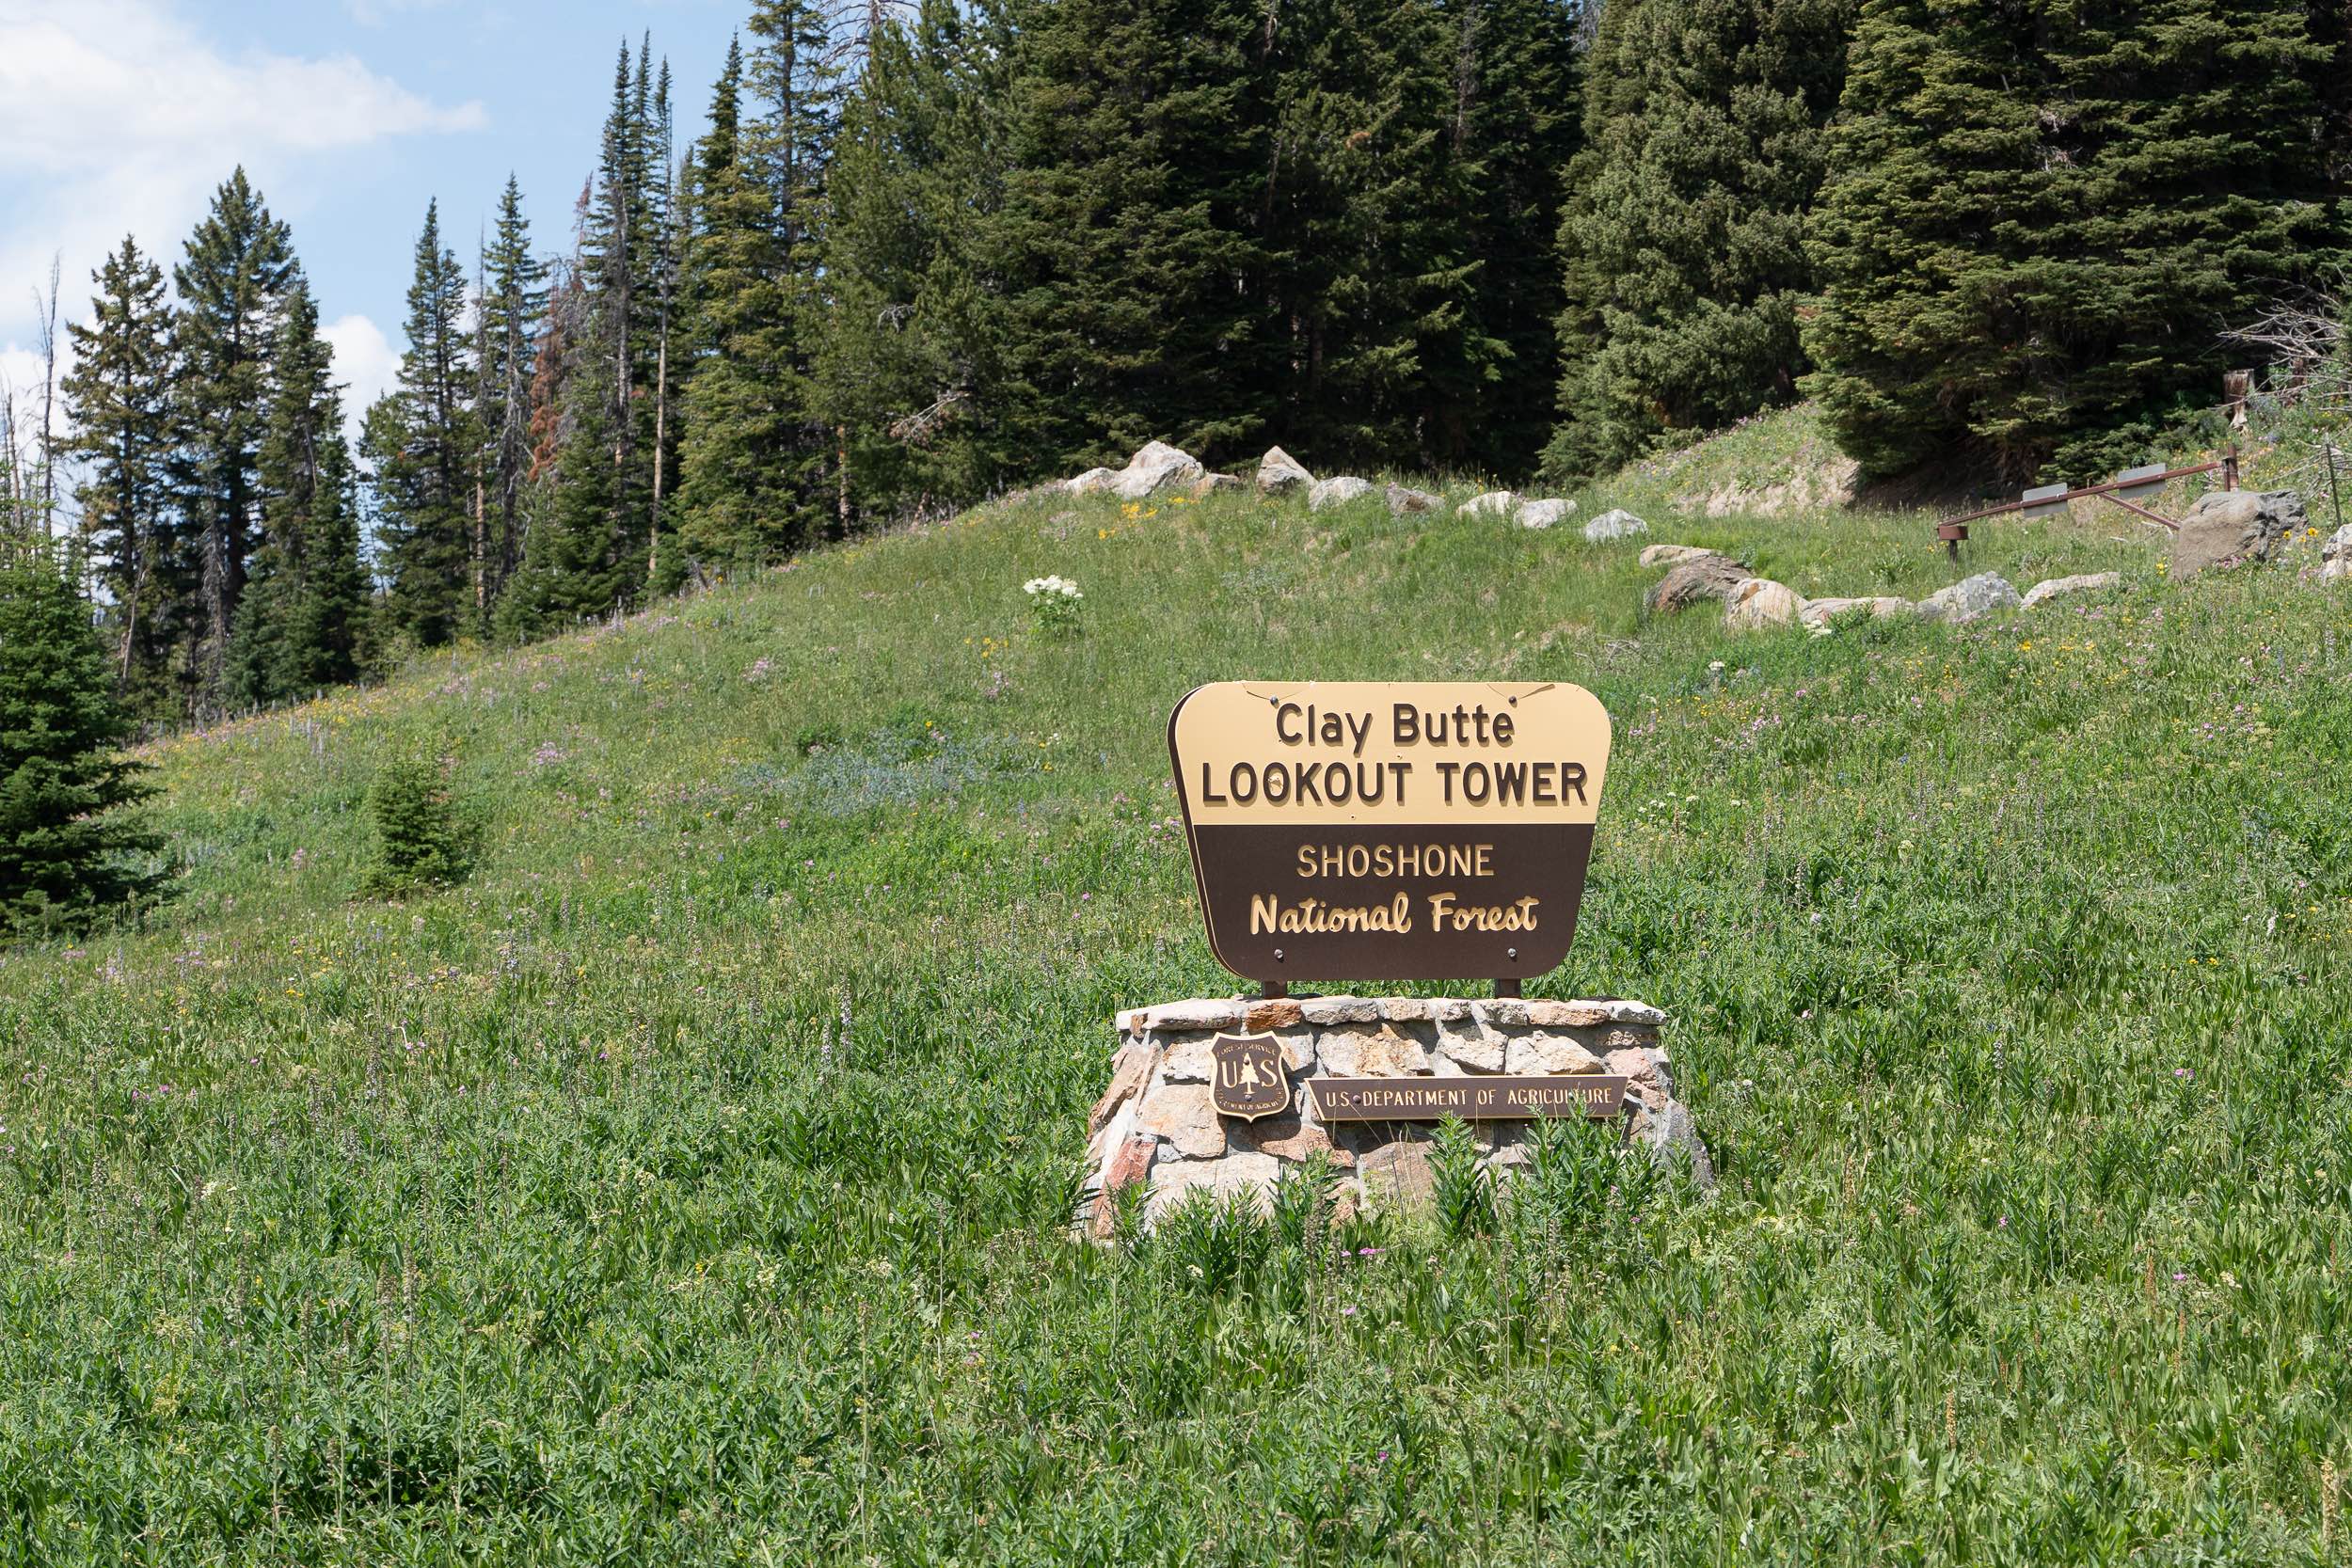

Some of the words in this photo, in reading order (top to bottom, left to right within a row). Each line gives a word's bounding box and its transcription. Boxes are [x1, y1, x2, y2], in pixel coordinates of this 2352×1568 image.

[1276, 703, 1373, 754] Clay
[1392, 703, 1515, 746] Butte
[1202, 761, 1412, 806] LOOKOUT
[1436, 761, 1588, 806] TOWER
[1295, 844, 1495, 878] SHOSHONE
[1250, 891, 1412, 934] National
[1426, 891, 1541, 932] Forest
[1363, 1089, 1468, 1107] DEPARTMENT
[1477, 1089, 1497, 1105] OF
